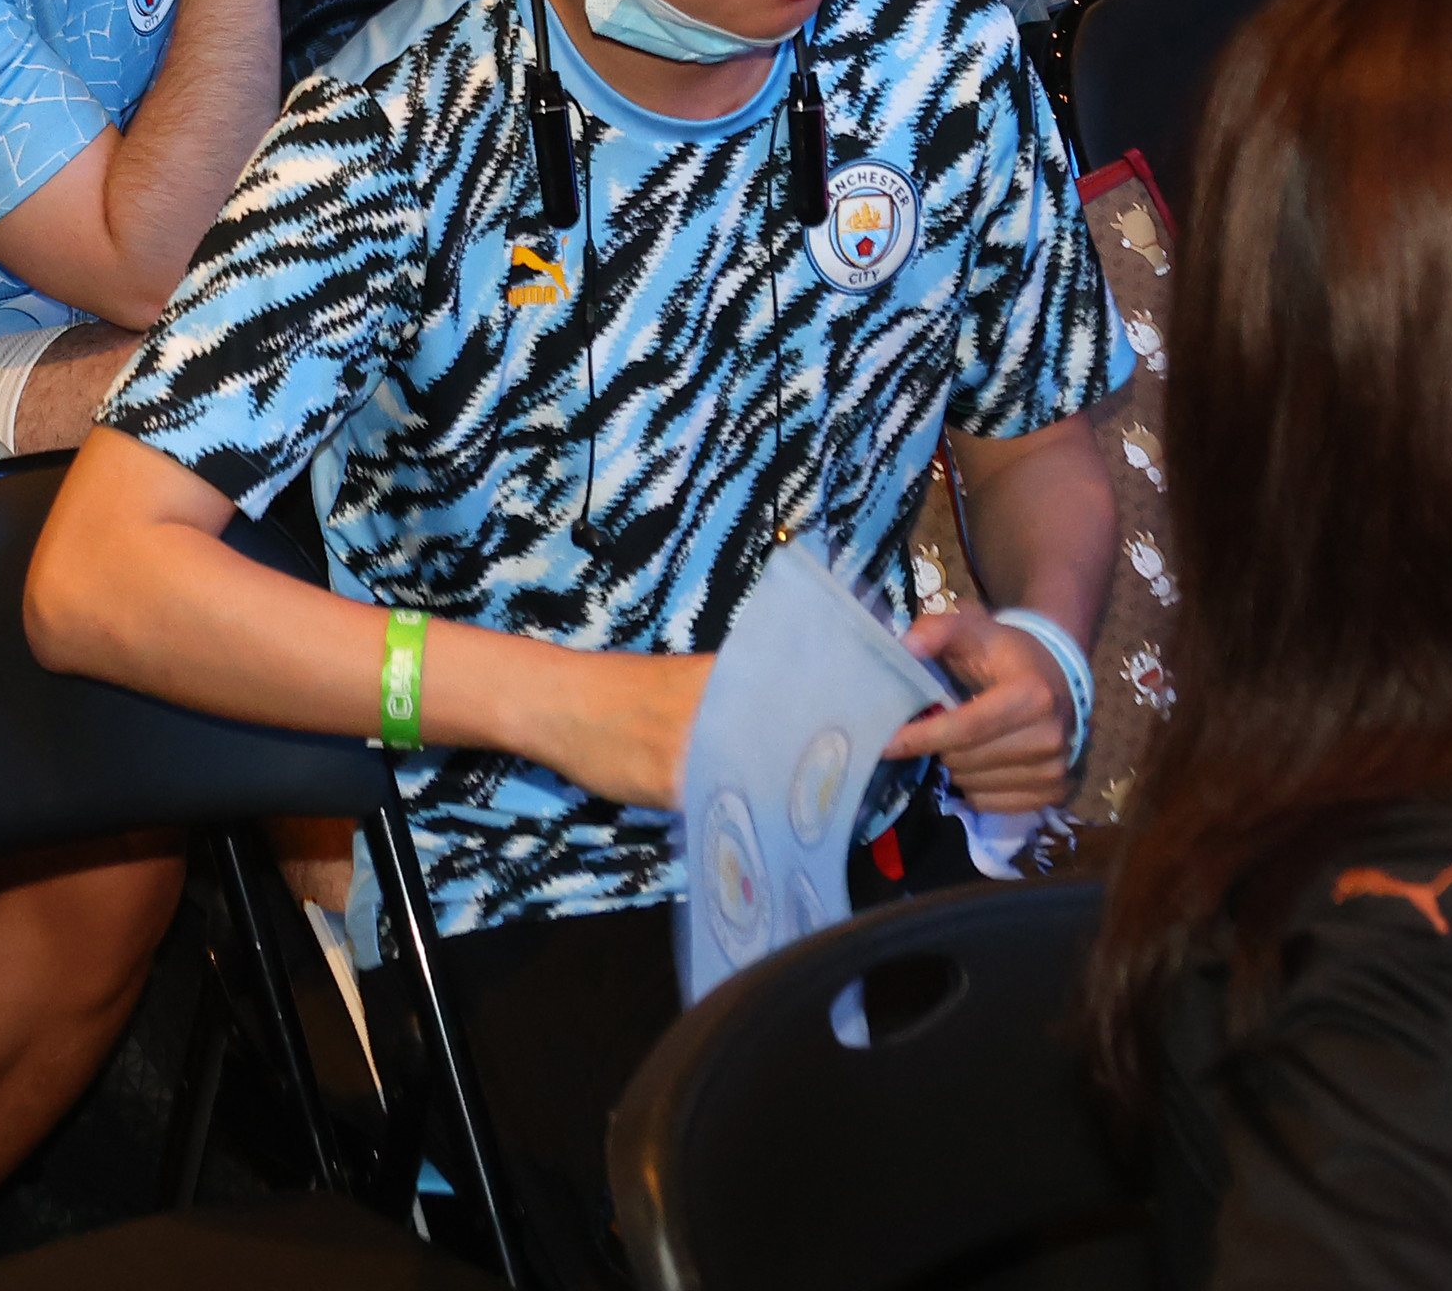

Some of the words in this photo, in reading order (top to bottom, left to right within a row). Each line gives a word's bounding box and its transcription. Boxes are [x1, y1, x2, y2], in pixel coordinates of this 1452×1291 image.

[143, 13, 160, 31] CITY
[827, 171, 910, 209] ANCHESTER
[849, 269, 881, 286] CITY
